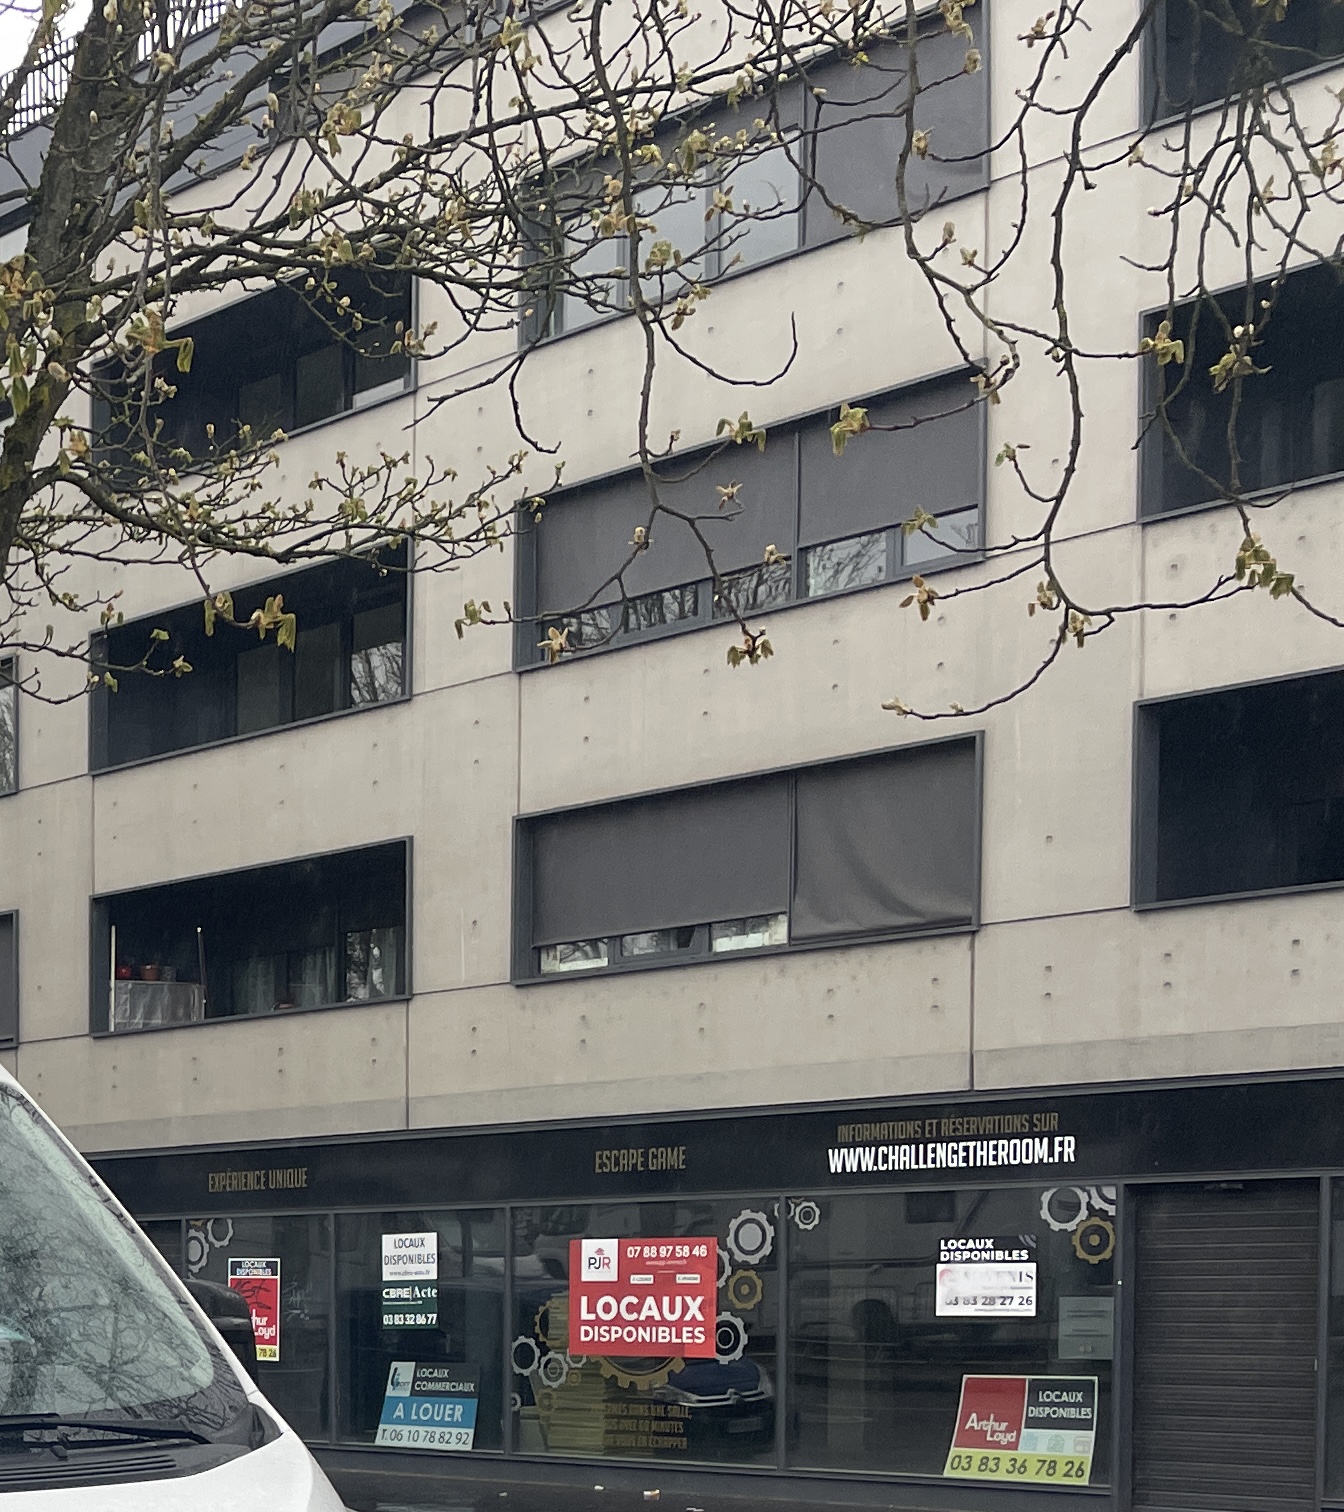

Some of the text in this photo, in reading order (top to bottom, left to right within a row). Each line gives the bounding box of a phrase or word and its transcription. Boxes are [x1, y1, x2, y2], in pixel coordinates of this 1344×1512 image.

[837, 1112, 1060, 1143] INFORMATIONS ET RÉSERVATIONS SUR
[594, 1146, 687, 1173] ESCAPE GAME
[827, 1135, 1076, 1174] WWW.CHALLENGETHEROOM.FR
[208, 1167, 308, 1193] EXPÉRIENCE UNIQUE
[393, 1237, 425, 1249] LOCAUX
[940, 1238, 994, 1250] LOCAUX
[627, 1245, 708, 1258] 07 88 97 58 46
[939, 1249, 1029, 1262] DISPONIBLES
[384, 1253, 436, 1266] DISPONIBLES
[587, 1256, 612, 1270] PJR
[413, 1286, 438, 1298] Acte
[999, 1296, 1014, 1306] 27
[1018, 1296, 1033, 1306] 26
[579, 1295, 705, 1322] LOCAUX
[383, 1314, 393, 1325] 03
[427, 1313, 438, 1325] 77
[579, 1325, 706, 1344] DISPONIBLES
[416, 1368, 450, 1378] LOCAUX
[414, 1381, 475, 1392] COMMERCIAUX
[1038, 1390, 1084, 1403] LOCAUX
[411, 1402, 464, 1422] LOUER
[1027, 1406, 1093, 1419] DISPONIBLES
[964, 1412, 1009, 1433] Arthur
[389, 1428, 404, 1441] 06
[407, 1429, 420, 1442] 10
[423, 1430, 436, 1443] 78
[438, 1431, 453, 1444] 82
[455, 1432, 470, 1445] 92
[986, 1429, 1017, 1445] Loyd
[950, 1455, 1085, 1478] 03 83 36 78 26
